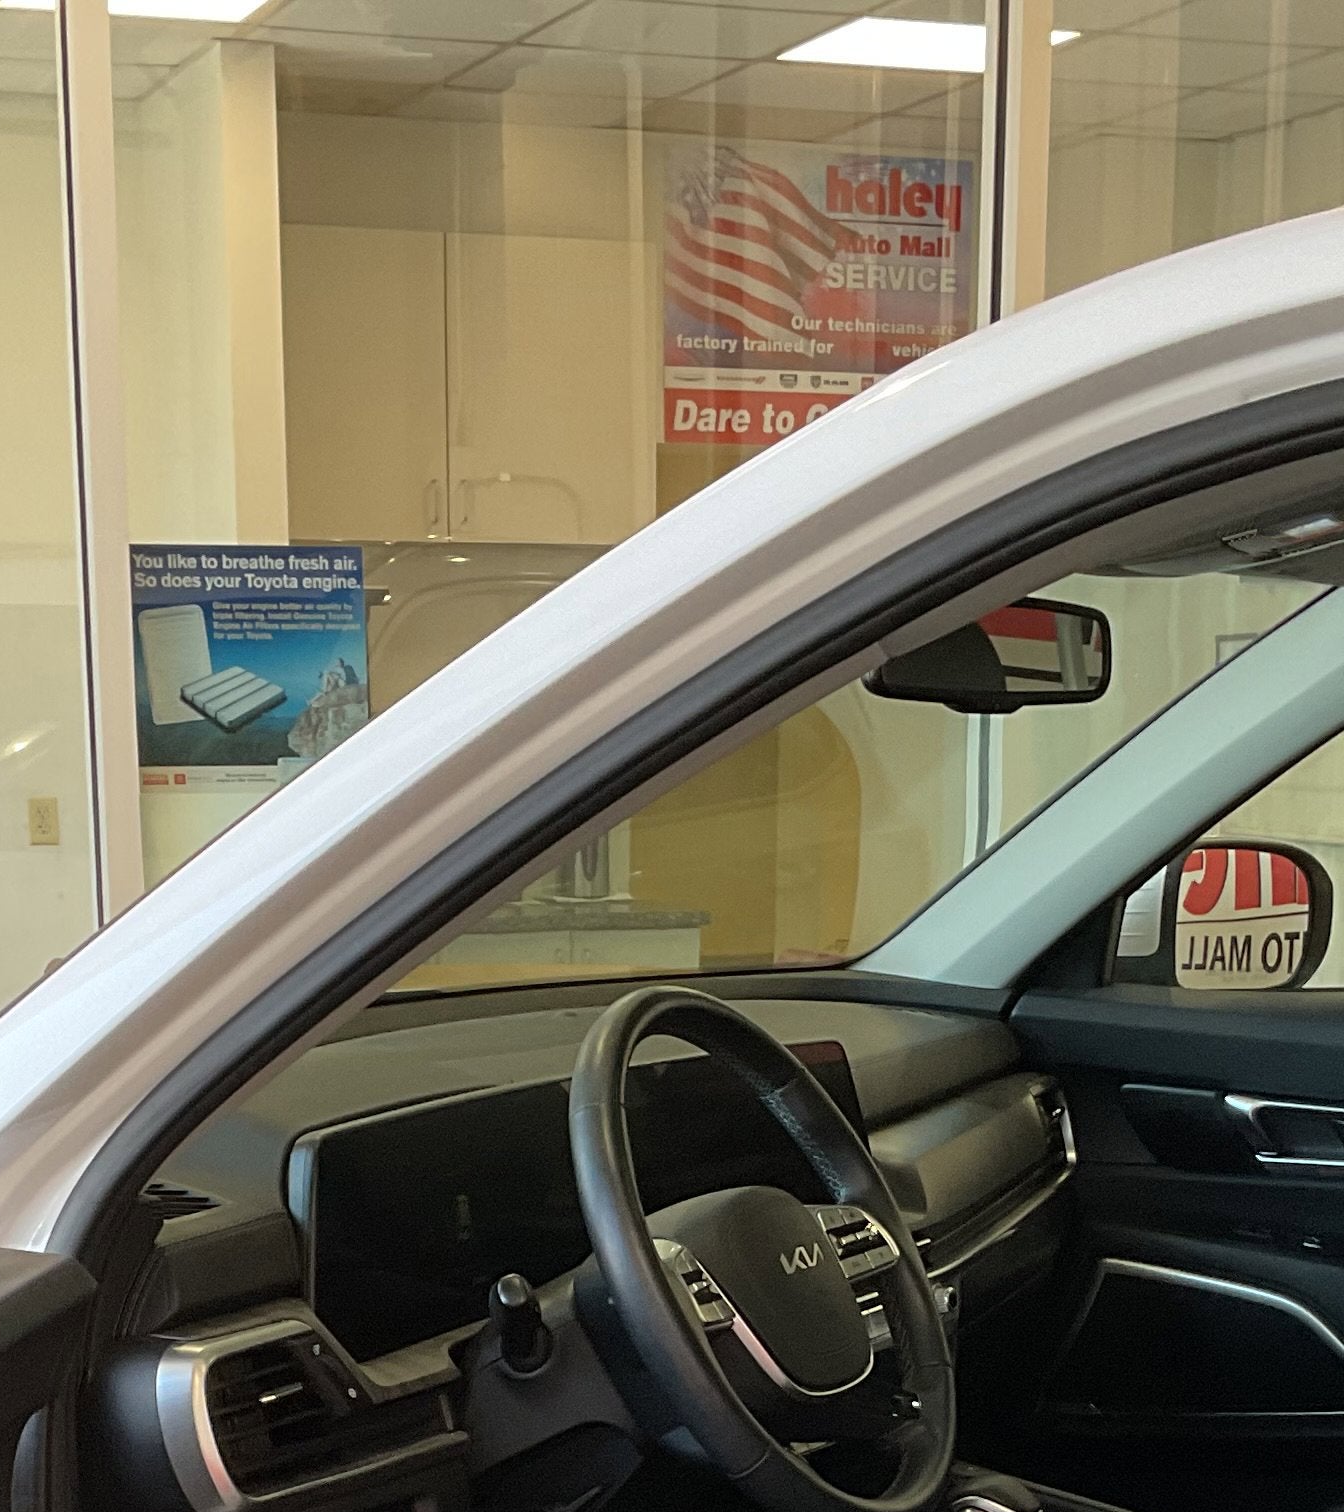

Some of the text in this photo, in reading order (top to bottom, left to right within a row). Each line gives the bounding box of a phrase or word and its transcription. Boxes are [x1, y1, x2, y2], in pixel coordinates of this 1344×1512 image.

[826, 165, 962, 233] haley
[835, 233, 952, 258] Auto Mall
[825, 262, 958, 293] SERVICE
[791, 315, 958, 336] Our technicians are
[676, 334, 835, 357] factory trained for
[673, 399, 751, 433] Dare
[762, 402, 796, 434] to
[132, 554, 358, 571] You like to breathe fresh air.
[134, 573, 361, 593] So does your Toyota engine.
[779, 1241, 825, 1275] KIA
